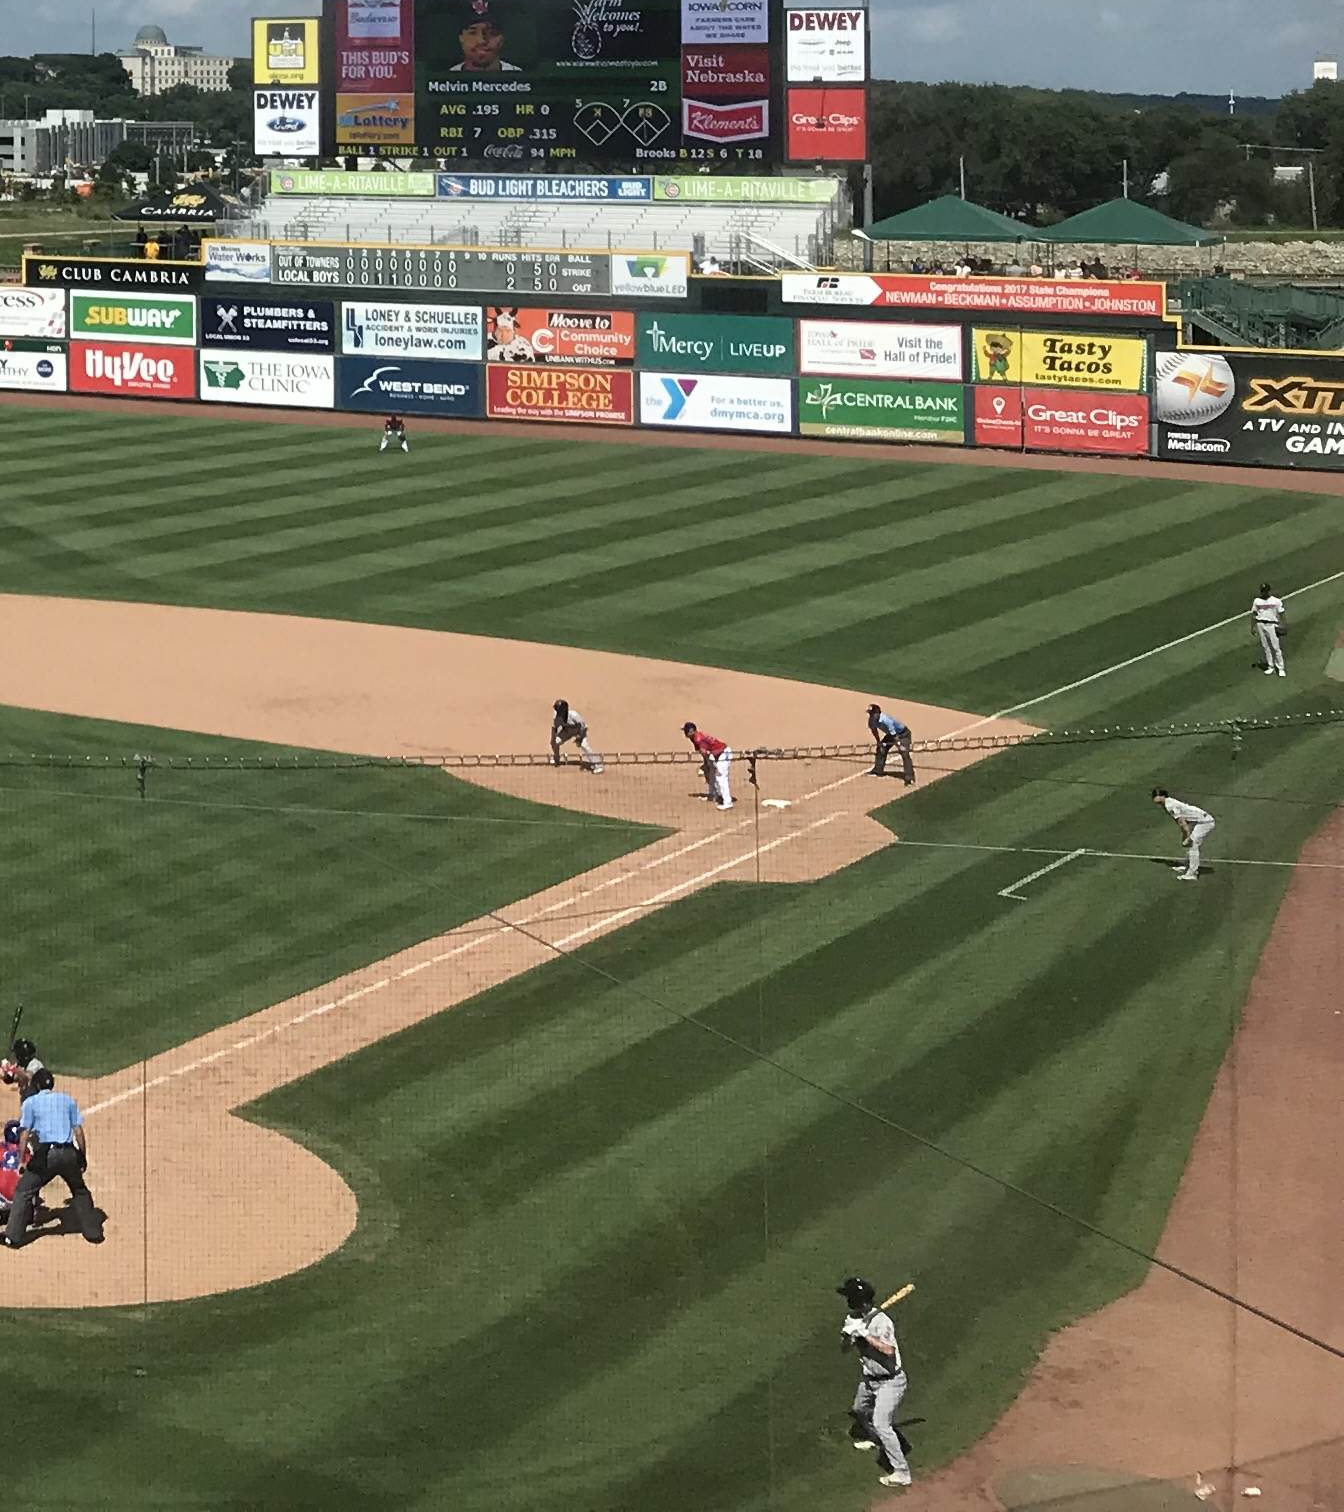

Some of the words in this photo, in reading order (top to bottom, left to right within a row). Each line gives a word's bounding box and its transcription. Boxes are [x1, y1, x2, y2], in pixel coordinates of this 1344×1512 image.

[688, 2, 719, 12] IOWA
[727, 2, 762, 11] CORN
[789, 12, 862, 31] DEWEY
[341, 51, 369, 65] THIS
[686, 54, 725, 67] Visit
[341, 65, 366, 79] FOR
[686, 70, 766, 84] Nebraska
[428, 81, 469, 92] Melvin
[472, 81, 532, 92] Mercedes
[650, 81, 668, 92] 2B
[256, 92, 318, 110] DEWEY
[440, 105, 466, 115] AVG
[472, 105, 500, 115] .195
[515, 105, 535, 115] HR
[440, 128, 464, 138] RBI
[474, 128, 482, 138] 7
[497, 128, 525, 138] OBP
[338, 146, 364, 155] BALL
[378, 146, 419, 155] STRIKE
[433, 147, 457, 156] OUT
[530, 148, 544, 158] 94
[549, 148, 576, 157] MPH
[636, 148, 676, 159] Brooks
[690, 149, 705, 159] 12
[719, 149, 728, 159] 6
[469, 179, 495, 195] BUD
[499, 179, 533, 196] LIGHT
[537, 180, 608, 197] BLEACHERS
[141, 207, 214, 216] CAMBRIA
[208, 251, 234, 262] Water
[278, 256, 293, 267] OUT
[294, 256, 304, 267] OF
[492, 253, 517, 262] RUNS
[521, 253, 542, 262] HITS
[545, 254, 560, 262] ERR
[568, 255, 592, 263] BALL
[62, 266, 102, 281] CLUB
[110, 268, 188, 285] CAMBRIA
[278, 270, 310, 282] LOCAL
[312, 271, 340, 283] BOYS
[561, 268, 592, 278] STRIKE
[572, 283, 592, 292] OUT
[1003, 284, 1026, 295] 2017
[1029, 285, 1054, 296] State
[1055, 286, 1110, 298] Champions
[886, 291, 937, 304] NEWMAN
[1008, 295, 1084, 311] ASSUMPTION
[1091, 297, 1156, 312] JOHNSTON
[84, 306, 182, 329] SUBWAY
[243, 305, 304, 319] PLUMBERS
[307, 307, 316, 319] &
[365, 308, 400, 322] LONEY
[415, 310, 478, 325] SCHUELLER
[243, 318, 329, 332] STEAMFITTERS
[374, 333, 466, 350] loneylaw.com
[560, 330, 632, 346] Community
[897, 336, 922, 349] Visit
[925, 337, 943, 350] the
[574, 343, 618, 356] Choice
[660, 336, 714, 361] Mercy
[1042, 337, 1112, 361] Tasty
[883, 349, 906, 362] Hall
[909, 350, 920, 363] of
[247, 361, 282, 377] THE
[286, 363, 330, 381] IOWA
[1042, 355, 1113, 375] Tacos
[248, 376, 307, 394] CLINIC
[506, 369, 613, 392] SIMPSON
[1034, 373, 1122, 386] tastytacos.com
[505, 389, 613, 410] COLLEGE
[645, 396, 663, 406] the
[710, 395, 726, 405] For
[736, 396, 767, 407] better
[843, 392, 913, 409] CENTRAL
[914, 395, 958, 412] BANK
[1027, 404, 1085, 423] Great
[1033, 425, 1052, 435] IT'S
[1053, 427, 1085, 437] GONNA
[1087, 429, 1100, 438] BE
[1101, 429, 1132, 439] GREAT
[1242, 420, 1254, 431] A
[1256, 418, 1286, 432] TV
[1288, 423, 1322, 434] AND
[1167, 439, 1226, 453] Mediacom
